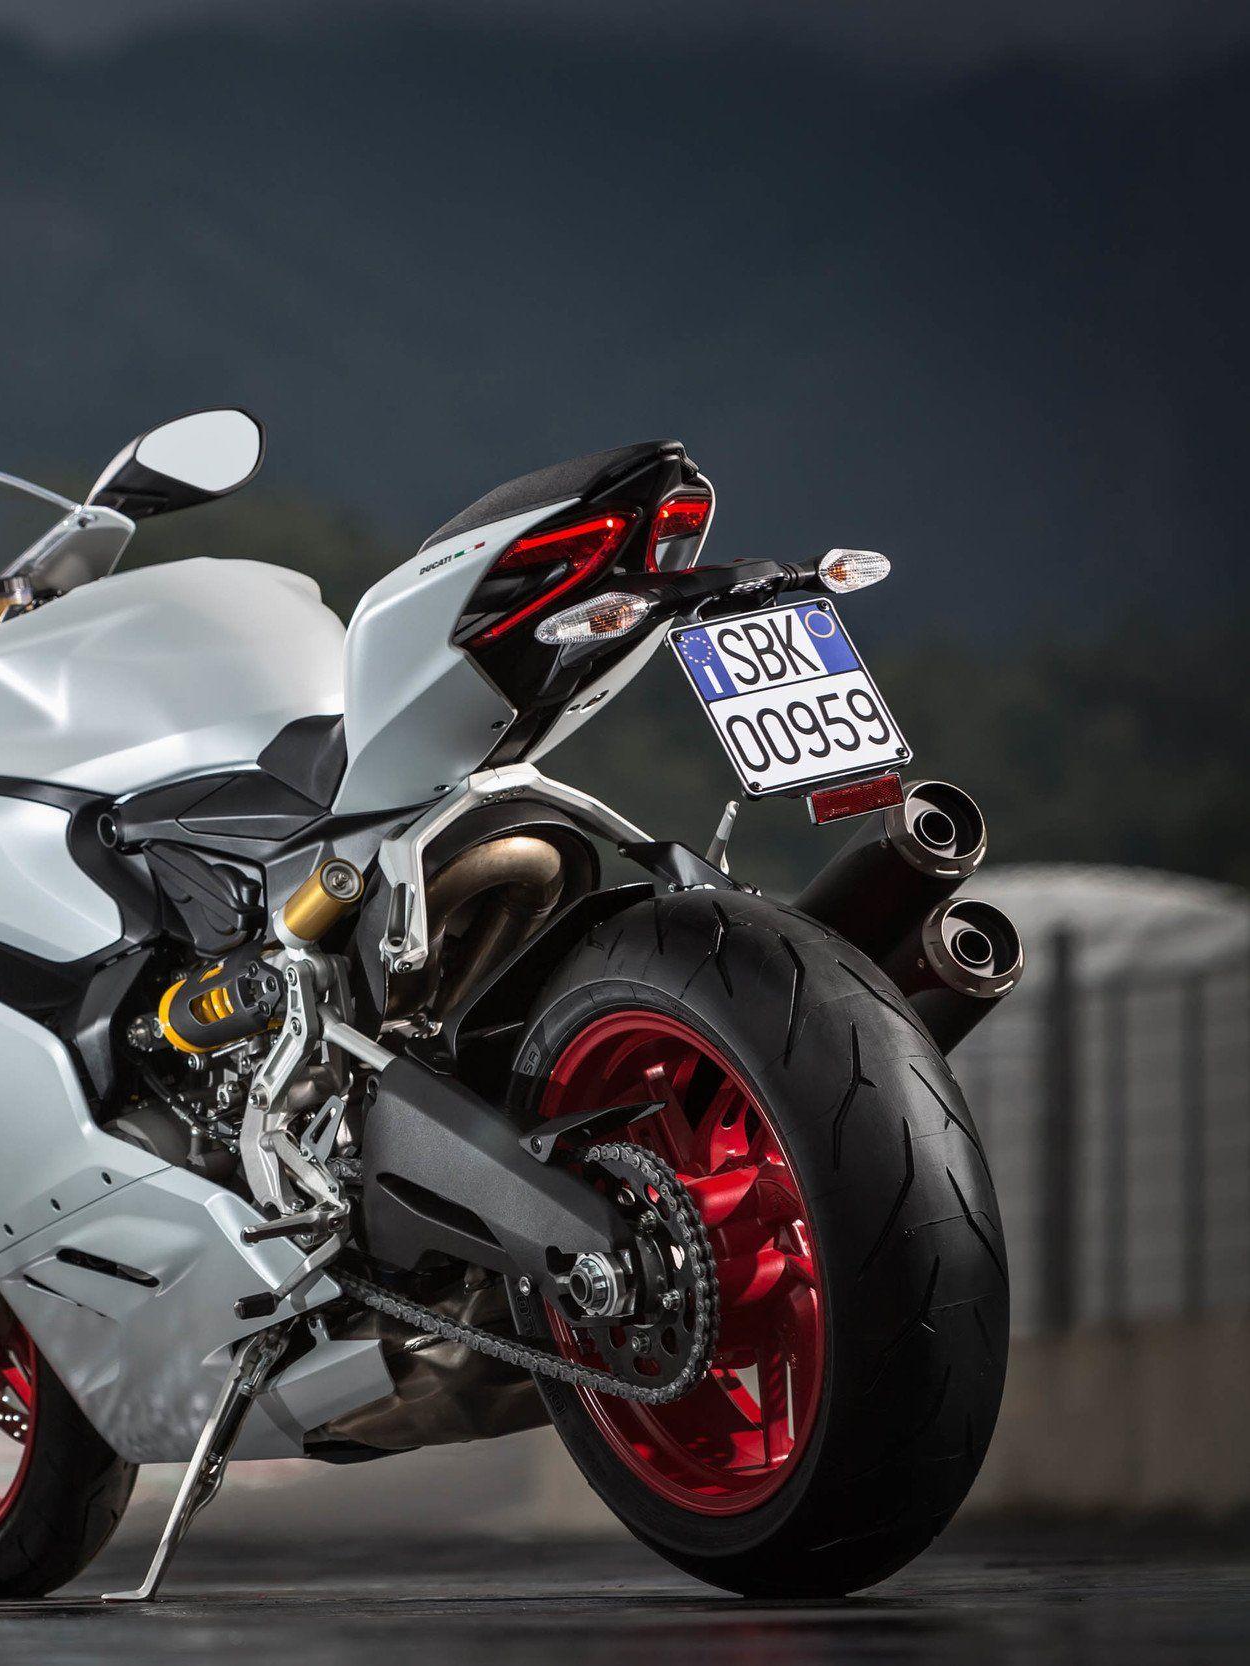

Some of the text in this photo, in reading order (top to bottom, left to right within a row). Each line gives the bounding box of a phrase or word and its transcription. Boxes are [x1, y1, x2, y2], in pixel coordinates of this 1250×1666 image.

[419, 555, 453, 576] DUCATI
[717, 614, 821, 687] SBK
[726, 688, 891, 774] 00959
